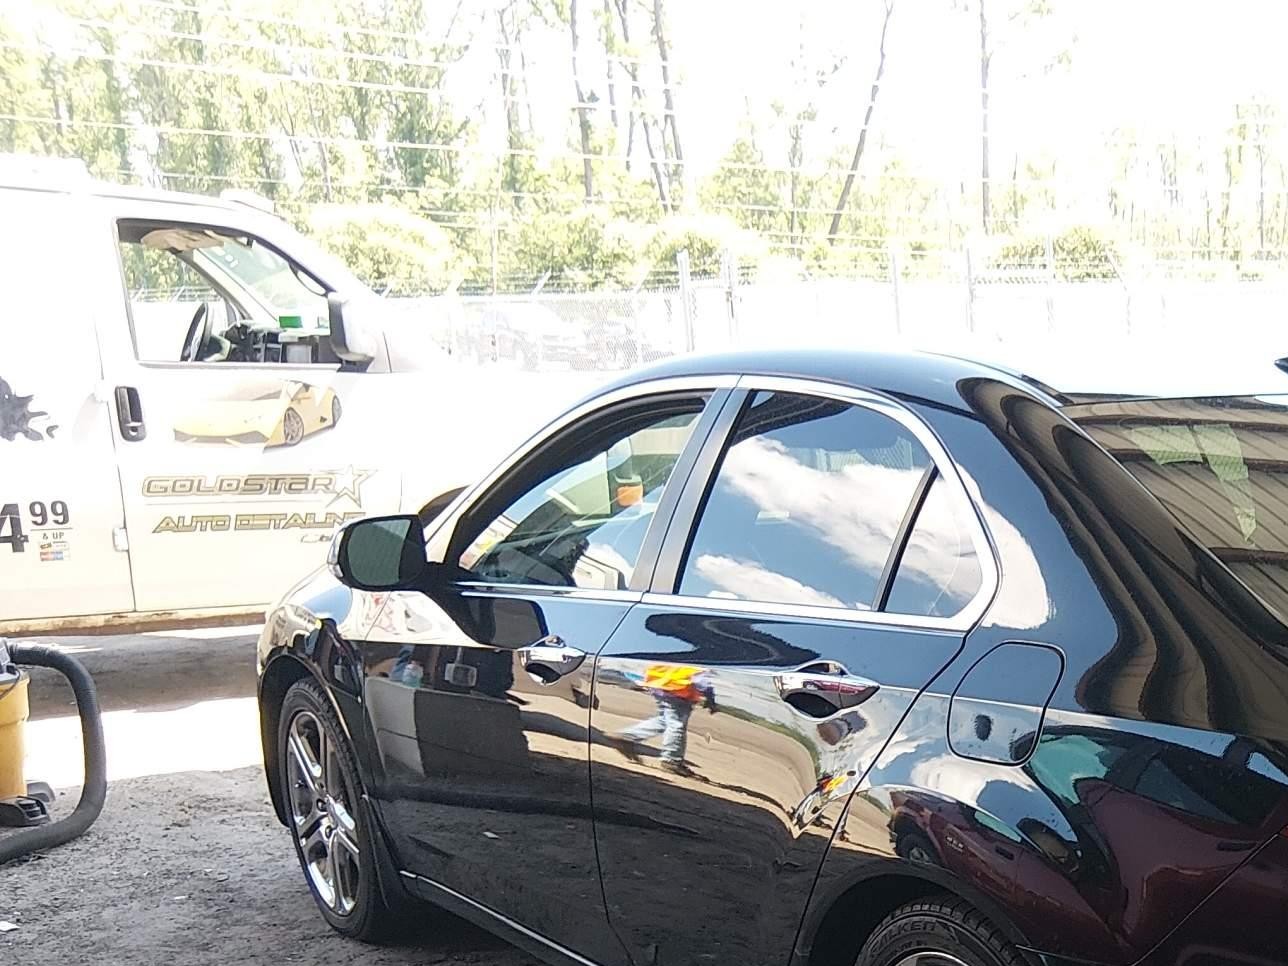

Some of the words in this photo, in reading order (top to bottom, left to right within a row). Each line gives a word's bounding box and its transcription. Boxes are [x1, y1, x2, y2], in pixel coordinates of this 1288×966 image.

[143, 474, 338, 497] GOLDSTAR
[152, 515, 231, 534] AUTO
[52, 531, 65, 540] UP
